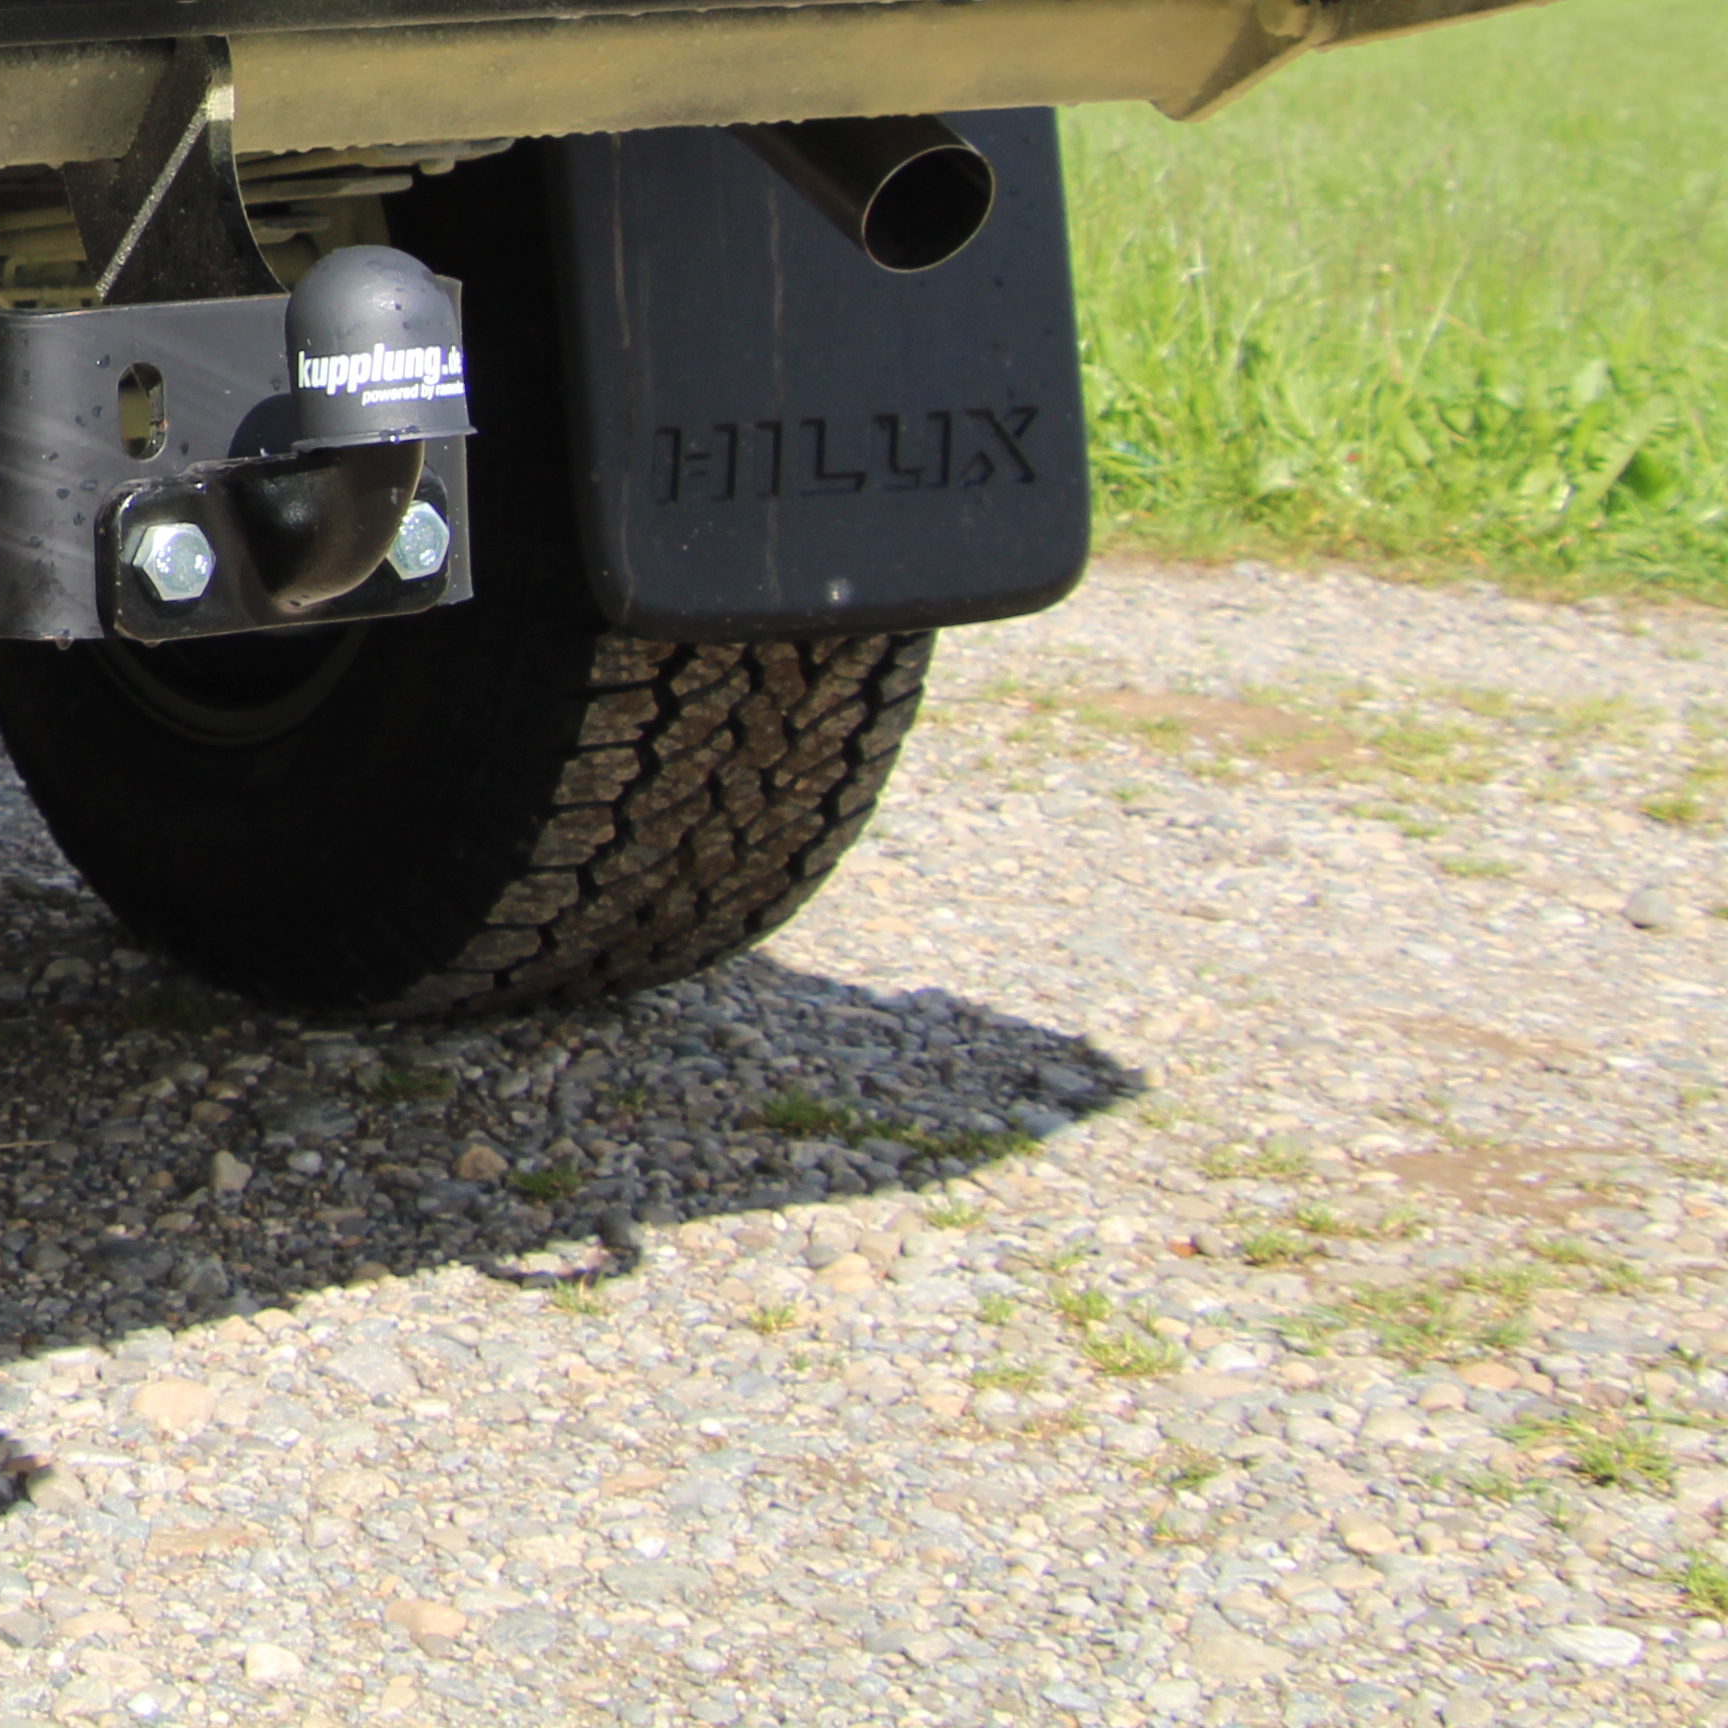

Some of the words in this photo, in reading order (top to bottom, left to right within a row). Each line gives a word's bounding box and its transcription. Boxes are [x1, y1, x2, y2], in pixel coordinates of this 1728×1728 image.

[298, 342, 463, 396] kupplung.de
[361, 383, 418, 408] powered
[420, 382, 435, 401] by
[652, 405, 1040, 504] HILUX
